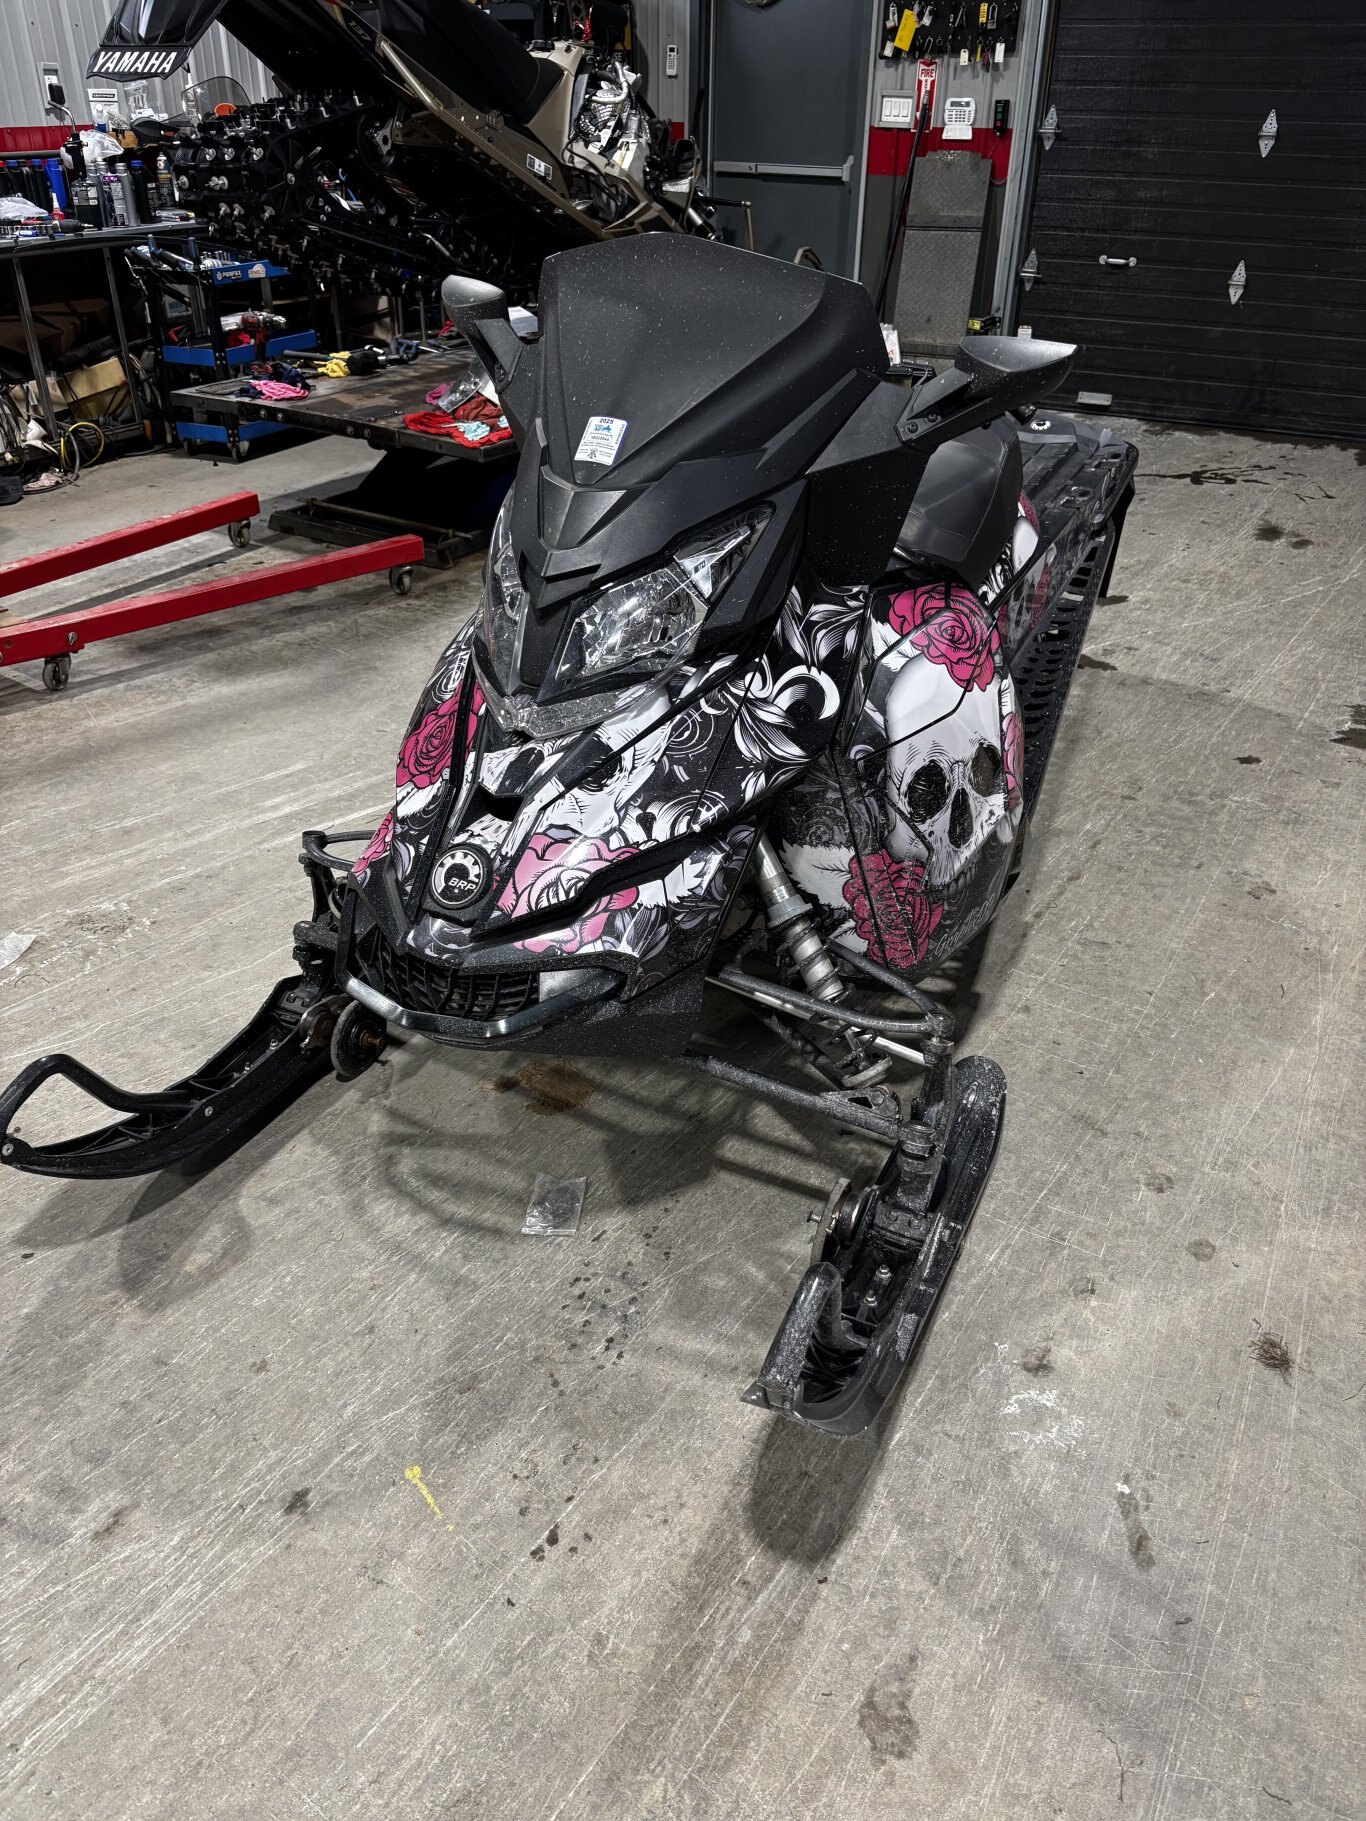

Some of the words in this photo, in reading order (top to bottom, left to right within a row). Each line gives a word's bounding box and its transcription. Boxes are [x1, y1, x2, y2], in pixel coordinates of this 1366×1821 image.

[92, 51, 178, 73] YAMAHA
[921, 68, 934, 78] FIRE
[448, 877, 477, 891] BRP
